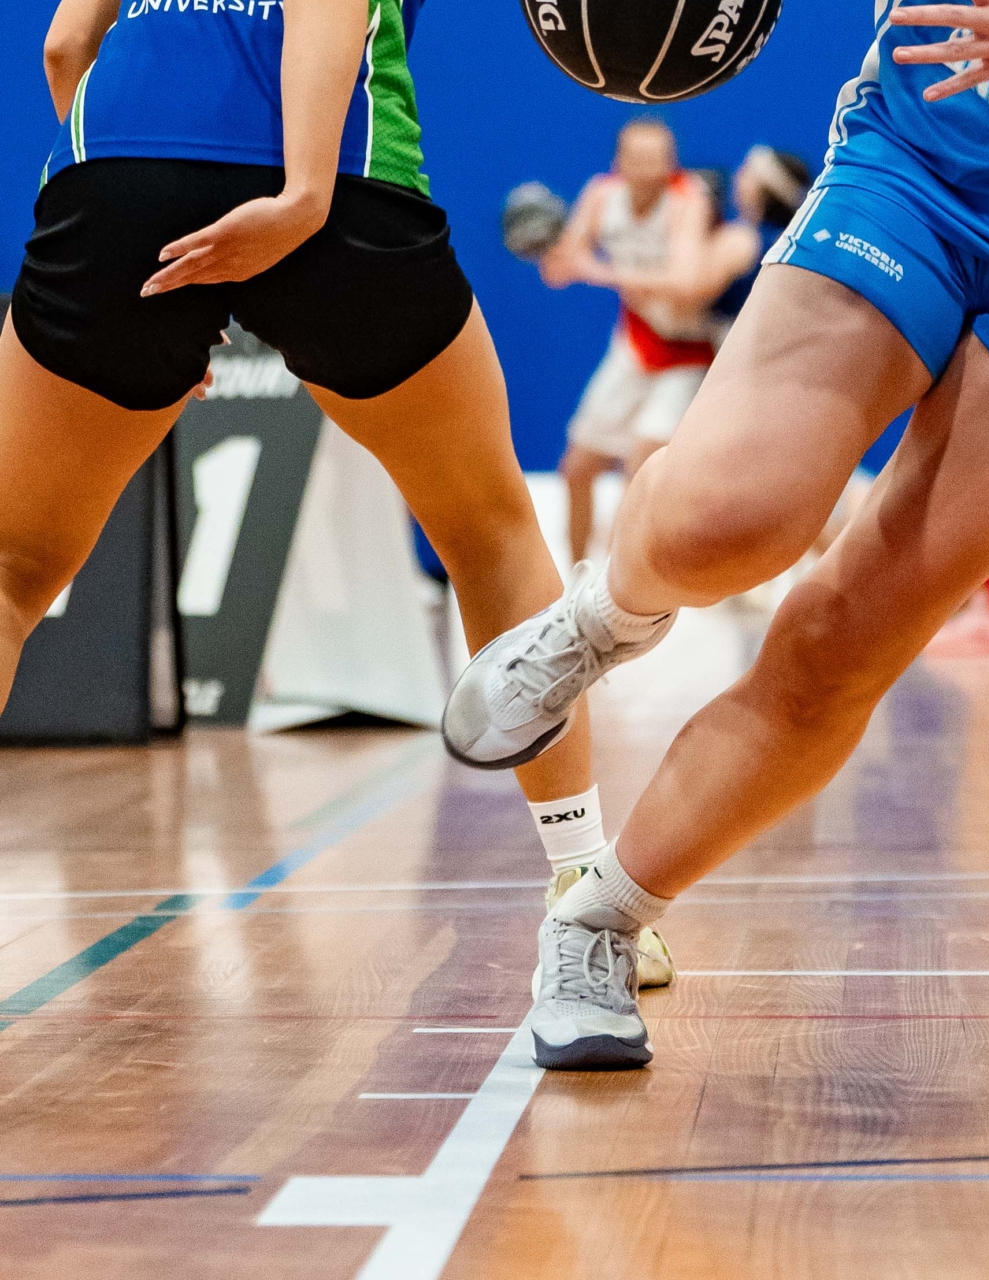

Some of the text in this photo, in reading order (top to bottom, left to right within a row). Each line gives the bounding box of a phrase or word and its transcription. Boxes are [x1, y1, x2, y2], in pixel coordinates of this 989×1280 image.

[835, 240, 903, 282] UNIVERSITY
[839, 232, 904, 277] VICTORIA
[540, 807, 586, 825] 2XU
